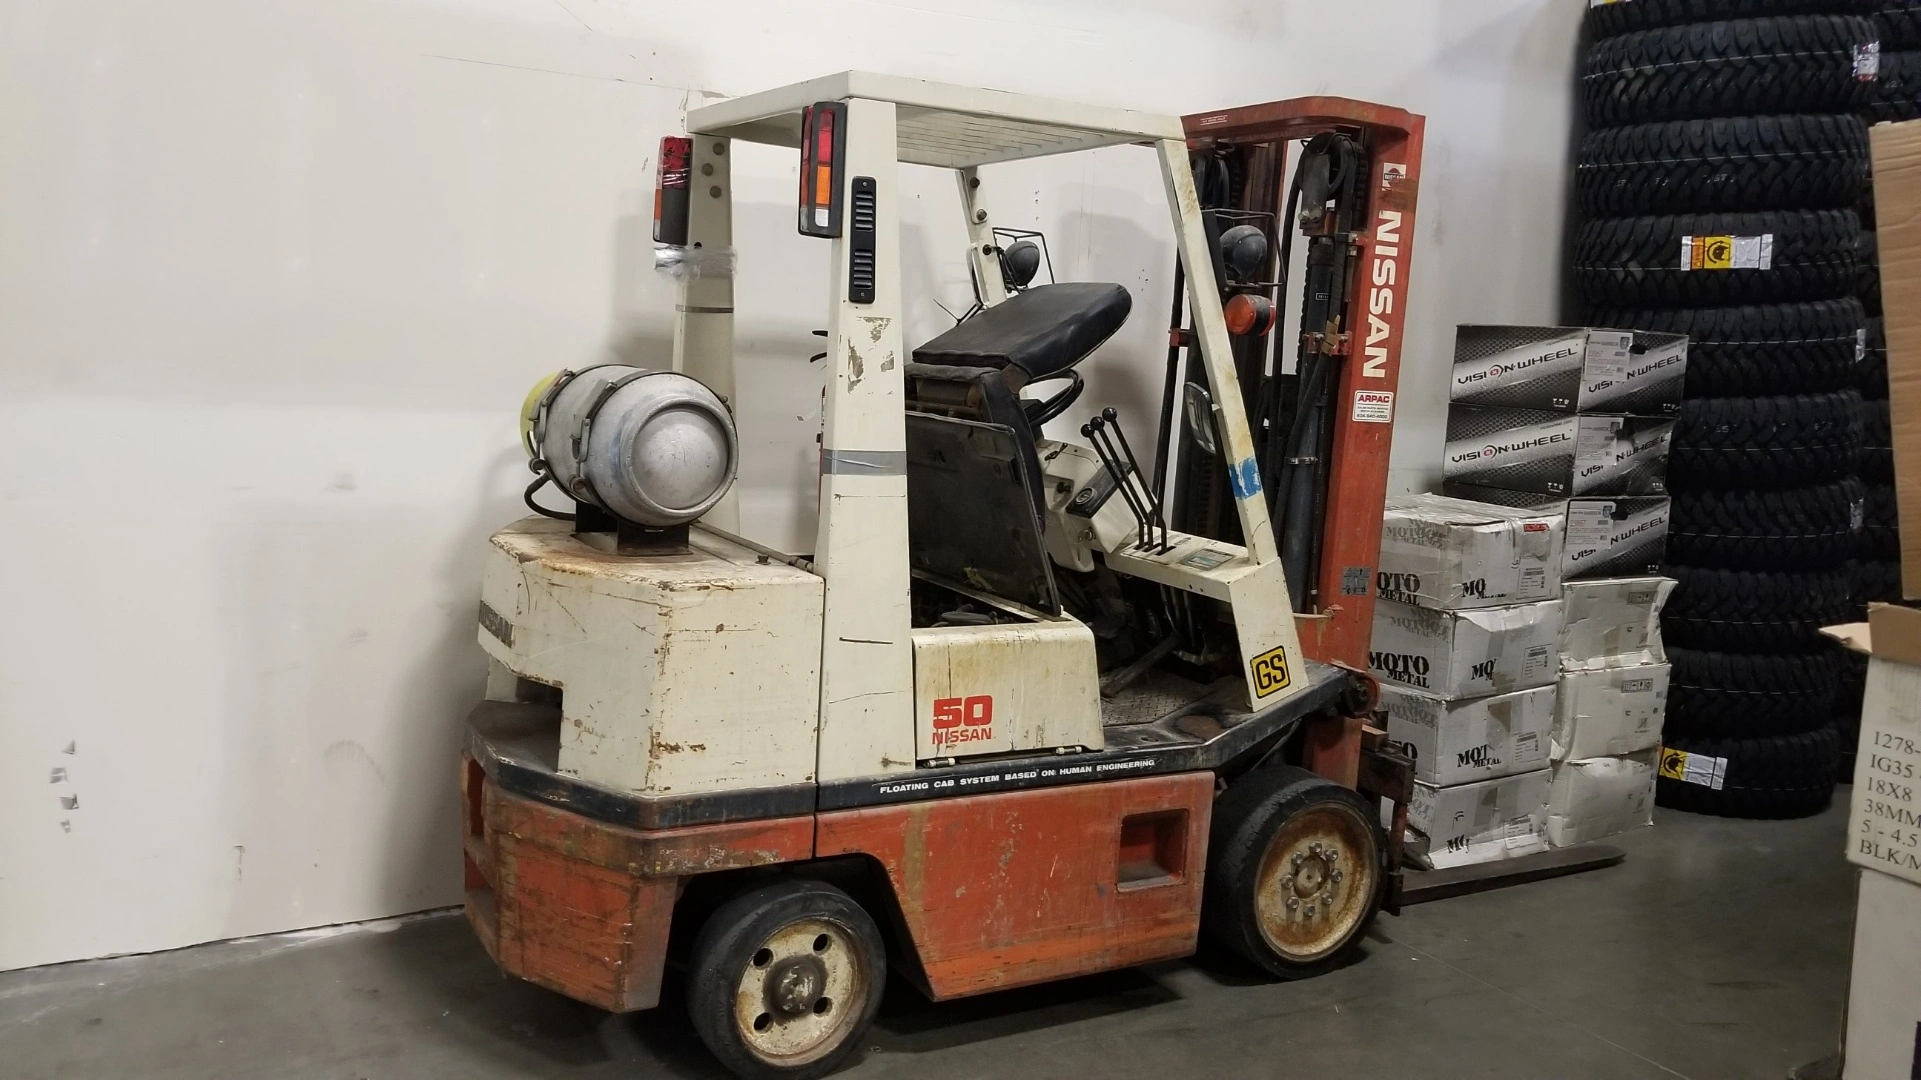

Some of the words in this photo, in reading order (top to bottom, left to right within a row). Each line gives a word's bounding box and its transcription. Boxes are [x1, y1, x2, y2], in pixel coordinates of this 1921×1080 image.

[1362, 210, 1402, 378] NISSAN
[1458, 364, 1515, 384] VISION
[1517, 348, 1577, 369] WHEEL
[1637, 355, 1682, 376] WHEEL
[1358, 394, 1390, 403] ARPAC
[1451, 445, 1509, 463] VISION
[1511, 433, 1571, 451] WHEEL
[1621, 517, 1665, 541] WHEEL
[1377, 572, 1420, 593] OTO
[1255, 653, 1286, 690] GS
[1368, 651, 1430, 675] MOTO
[1387, 668, 1430, 689] METAL
[933, 695, 993, 729] 50
[932, 727, 992, 745] NISSAN
[880, 782, 929, 793] FLOATING
[934, 779, 955, 788] CAB
[960, 775, 1000, 785] SYSTEM
[1005, 771, 1037, 781] BASED
[1041, 769, 1055, 777] ON
[1060, 765, 1092, 775] HUMAN
[1096, 759, 1155, 771] ENGINEERING
[1870, 754, 1914, 778] IG35
[1867, 777, 1912, 802] 18X8
